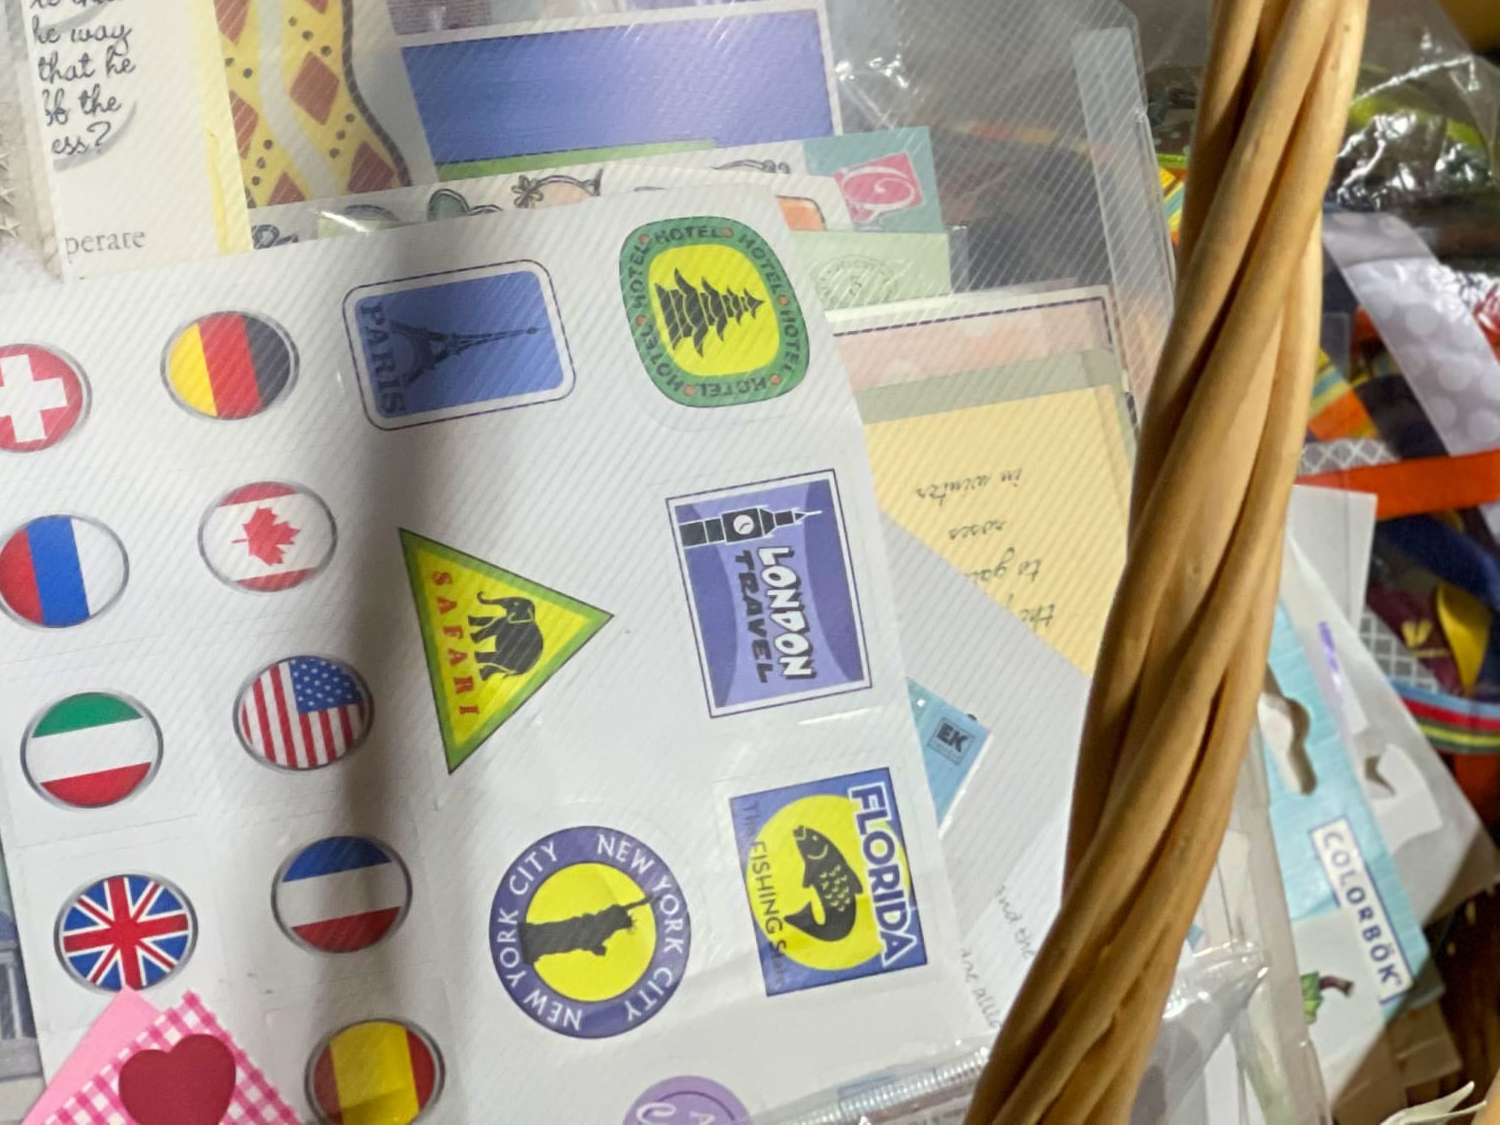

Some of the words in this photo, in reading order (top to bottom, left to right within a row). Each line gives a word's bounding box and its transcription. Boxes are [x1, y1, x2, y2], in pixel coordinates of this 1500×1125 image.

[38, 50, 95, 84] that
[105, 45, 136, 77] he
[78, 83, 122, 117] the
[654, 225, 722, 244] HOTEL
[738, 233, 782, 295] HOTEL
[361, 301, 405, 413] PARIS
[432, 571, 480, 715] SAFARI
[735, 550, 773, 683] TRAVEL
[757, 546, 818, 680] LONDON
[936, 724, 970, 755] EK
[509, 841, 557, 895] CITY
[597, 834, 654, 874] NEW
[848, 781, 917, 968] FLORIDA
[653, 875, 685, 955] YORK
[750, 840, 784, 935] FISHING
[497, 907, 527, 987] YORK
[524, 989, 582, 1030] NEW
[625, 967, 672, 1022] CITY
